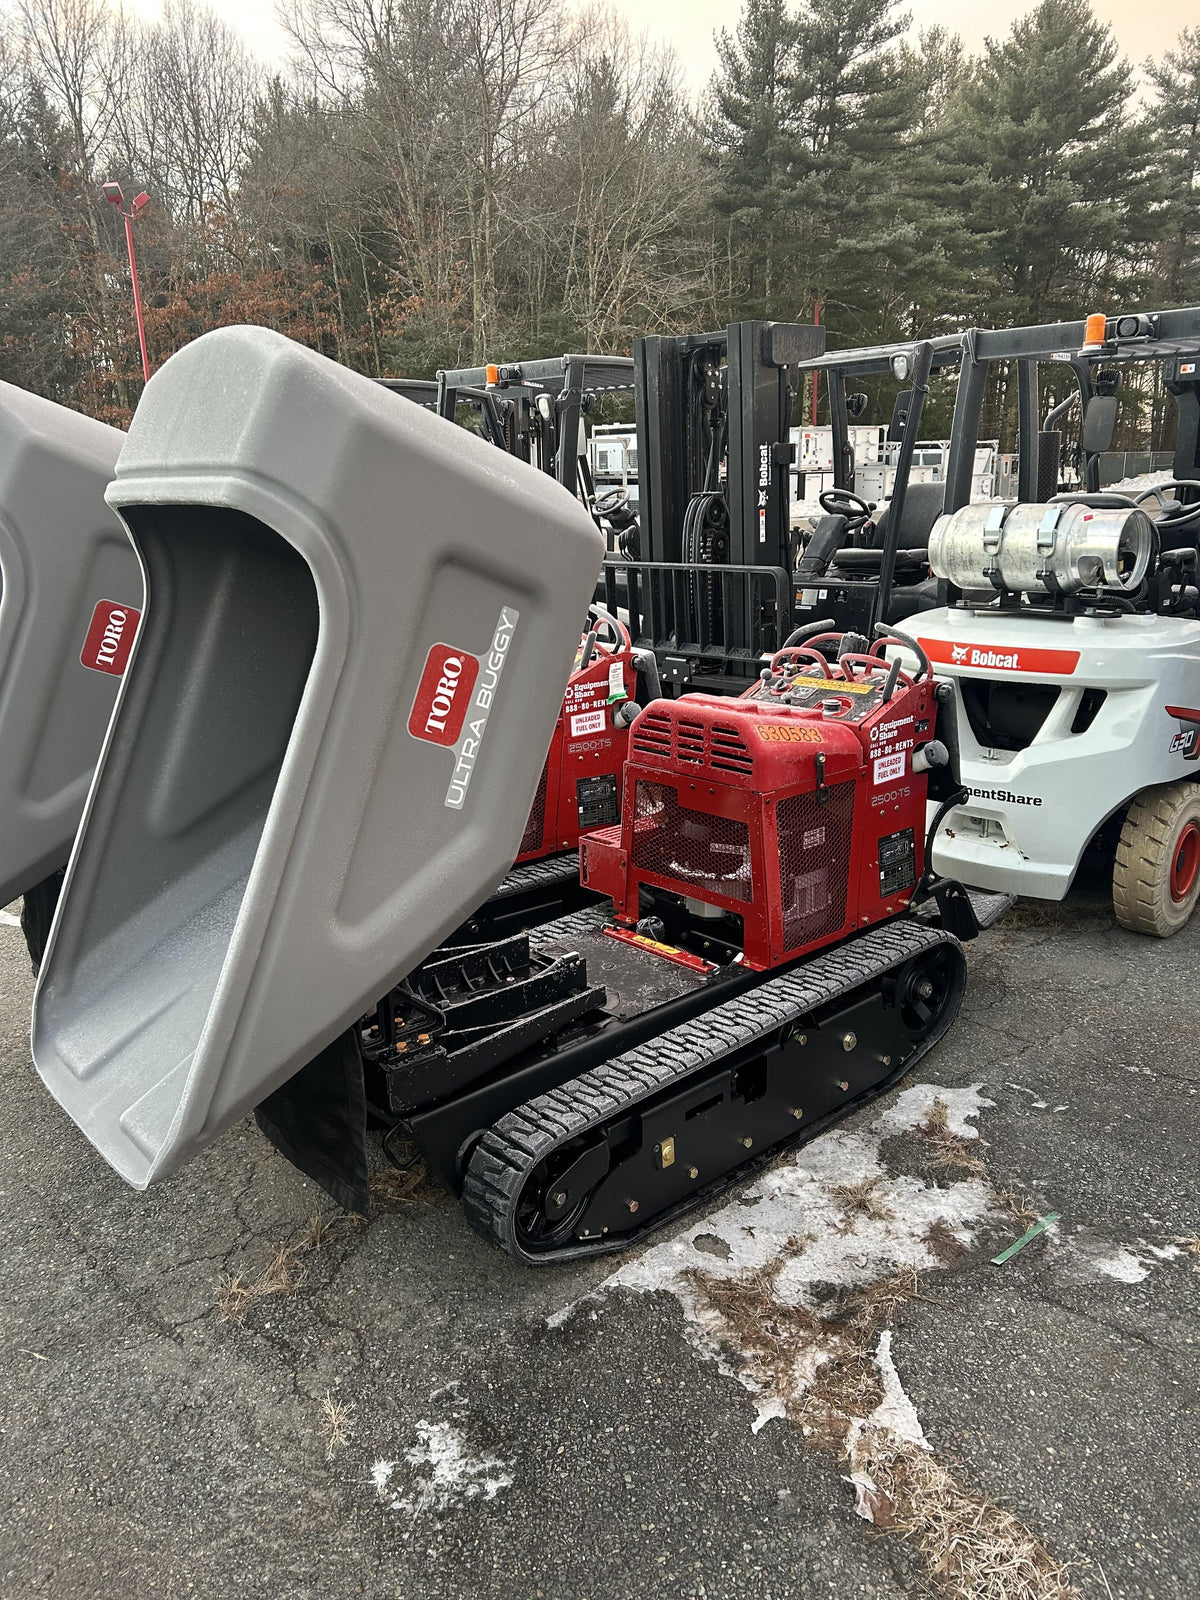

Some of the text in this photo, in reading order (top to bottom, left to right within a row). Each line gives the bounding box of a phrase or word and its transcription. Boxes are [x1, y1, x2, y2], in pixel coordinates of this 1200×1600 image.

[759, 444, 768, 487] Bobcat
[96, 610, 126, 666] TORO
[970, 649, 1019, 669] Bobcat
[574, 680, 609, 692] Equipmen
[574, 690, 595, 699] Share
[425, 657, 462, 734] TORO
[447, 612, 514, 805] ULTRA BUGGY
[565, 699, 609, 713] 888-80-RENT
[575, 713, 601, 725] UNLEADED
[576, 722, 601, 733] FUEL ONLY
[879, 715, 914, 732] Equipment
[757, 725, 822, 743] 630583
[879, 729, 898, 741] Share
[1169, 729, 1195, 753] G30
[869, 739, 914, 759] 888-80-RENTS
[878, 756, 902, 770] UNLEADED
[877, 766, 901, 780] FUEL ONLY
